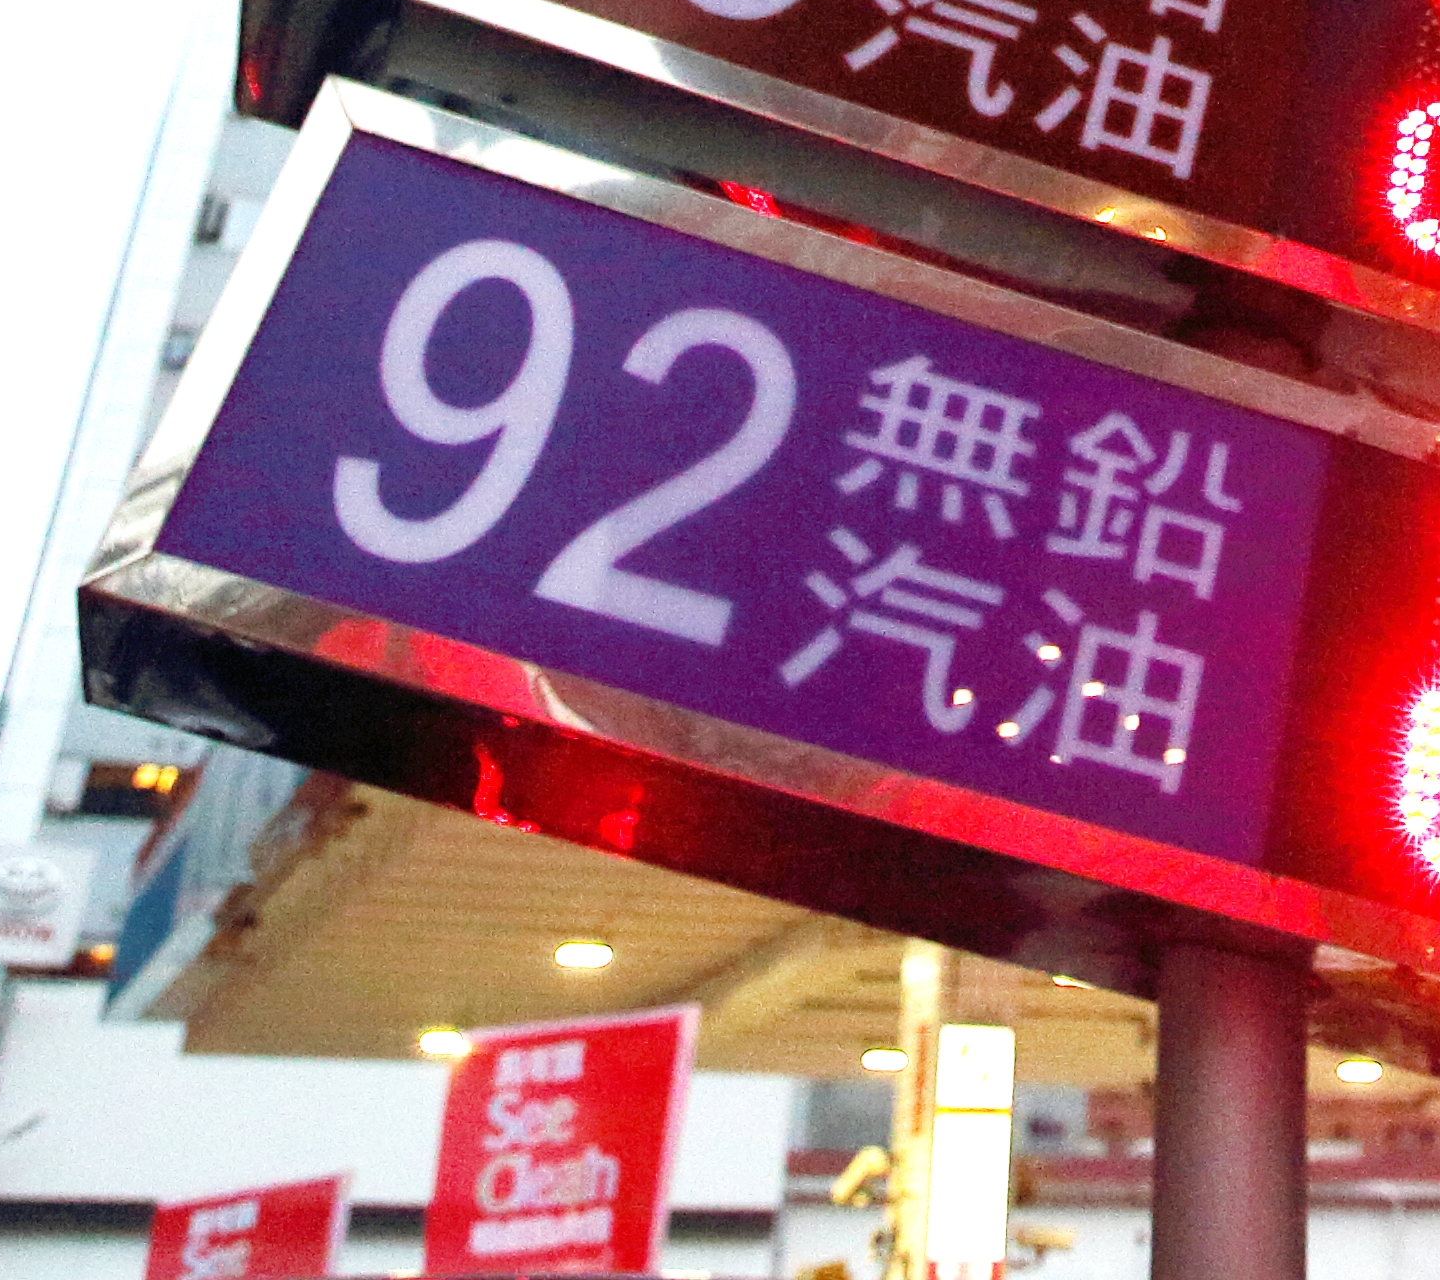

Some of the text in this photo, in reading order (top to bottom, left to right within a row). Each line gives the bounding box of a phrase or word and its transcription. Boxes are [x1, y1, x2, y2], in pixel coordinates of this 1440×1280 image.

[332, 238, 796, 647] 92
[833, 354, 1245, 601] 無鉛
[778, 526, 1207, 796] 汽油
